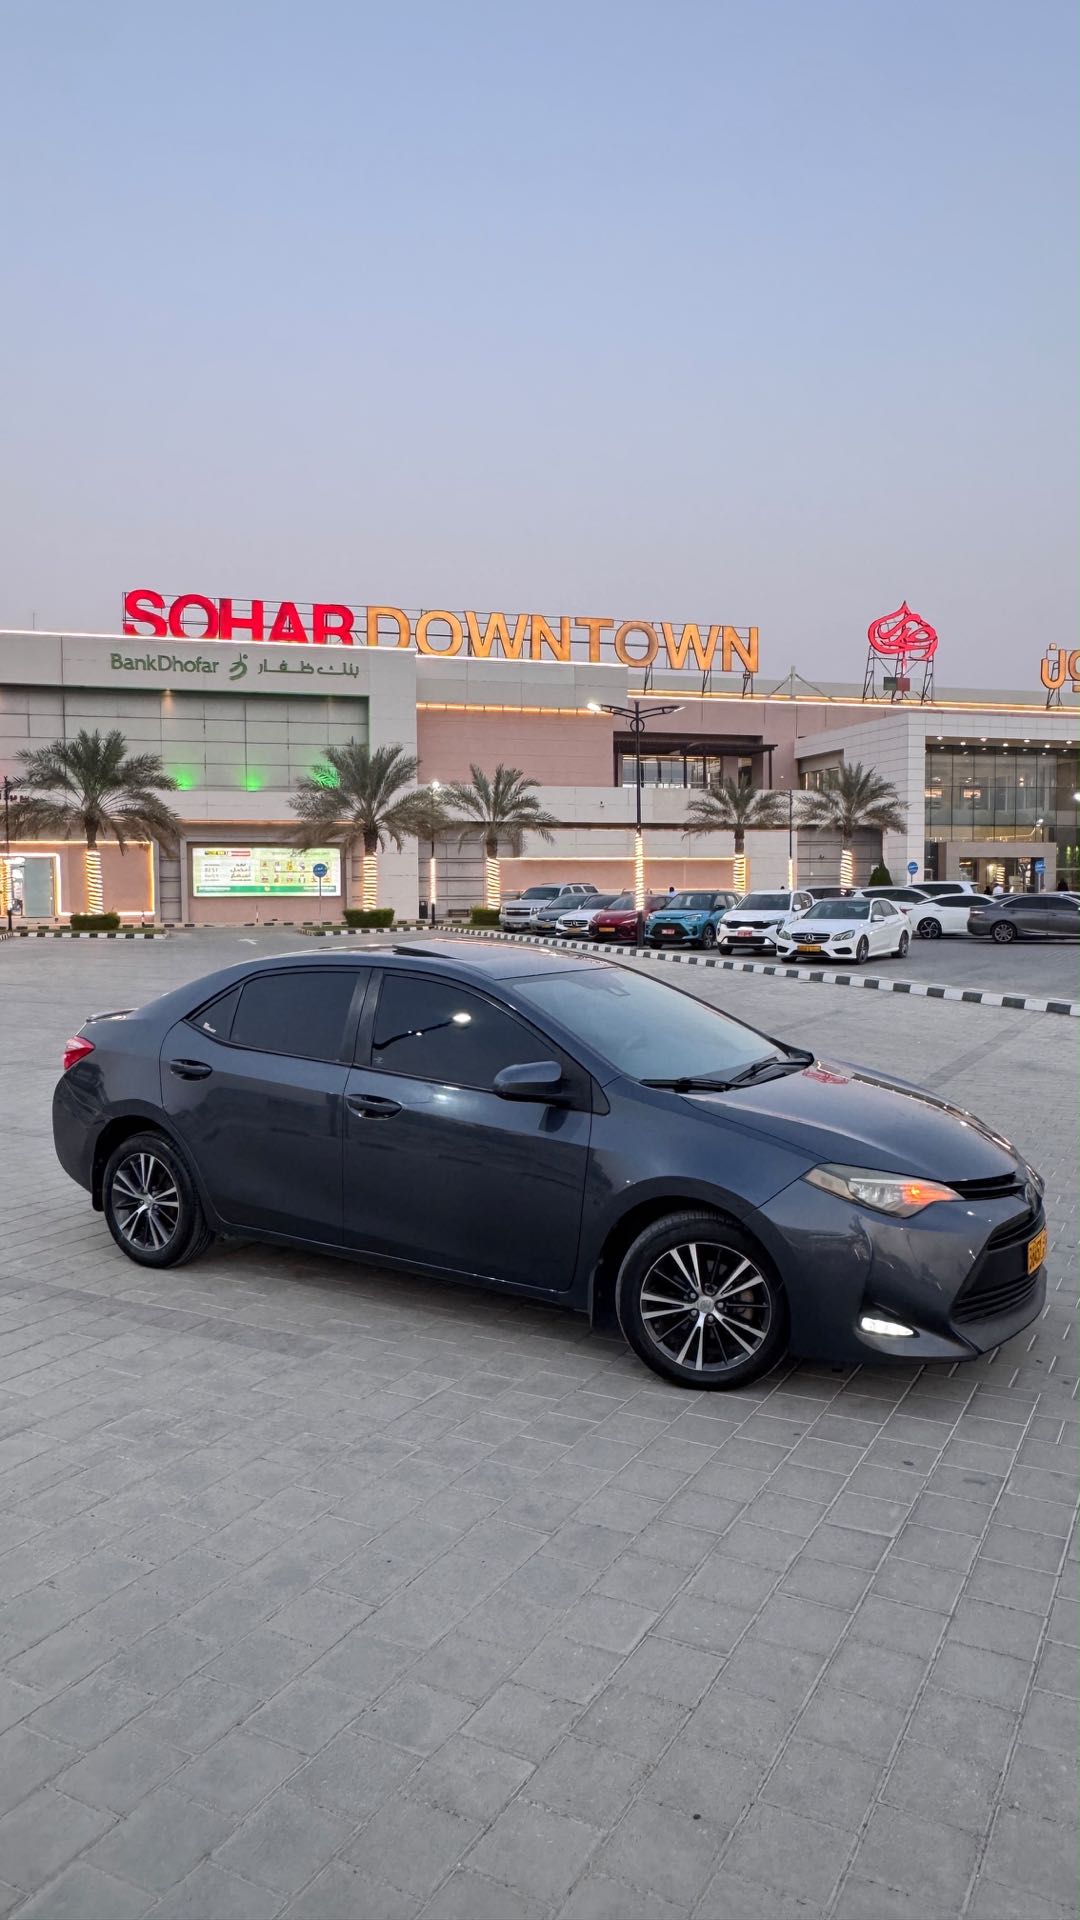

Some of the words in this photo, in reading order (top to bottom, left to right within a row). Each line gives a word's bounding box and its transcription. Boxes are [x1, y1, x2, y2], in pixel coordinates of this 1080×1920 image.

[123, 589, 355, 646] SOHAR
[366, 605, 759, 674] DOWNTOWN
[110, 653, 220, 674] BankDhofar
[258, 658, 315, 675] ظفار
[317, 661, 360, 679] بنك
